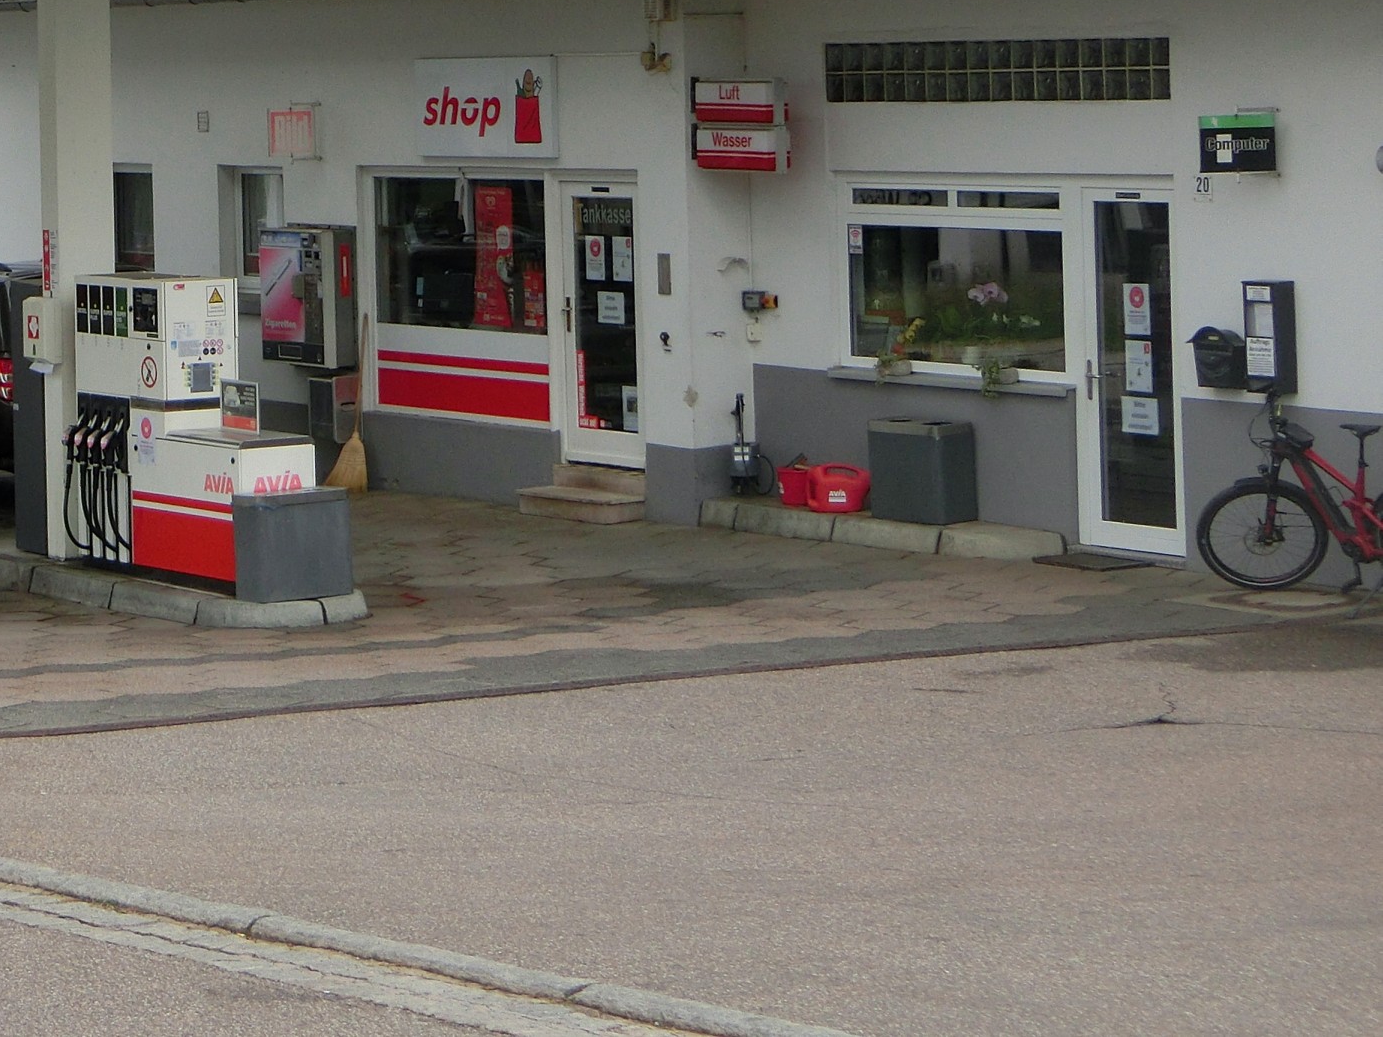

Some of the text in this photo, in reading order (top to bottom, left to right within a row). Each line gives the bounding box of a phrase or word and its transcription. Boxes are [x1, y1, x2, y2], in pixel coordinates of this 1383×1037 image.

[719, 85, 740, 100] Luft
[423, 86, 501, 137] shop
[711, 132, 752, 147] Wasser
[1205, 137, 1269, 153] Computer
[1196, 177, 1209, 192] 20
[578, 204, 631, 224] Tankkasse
